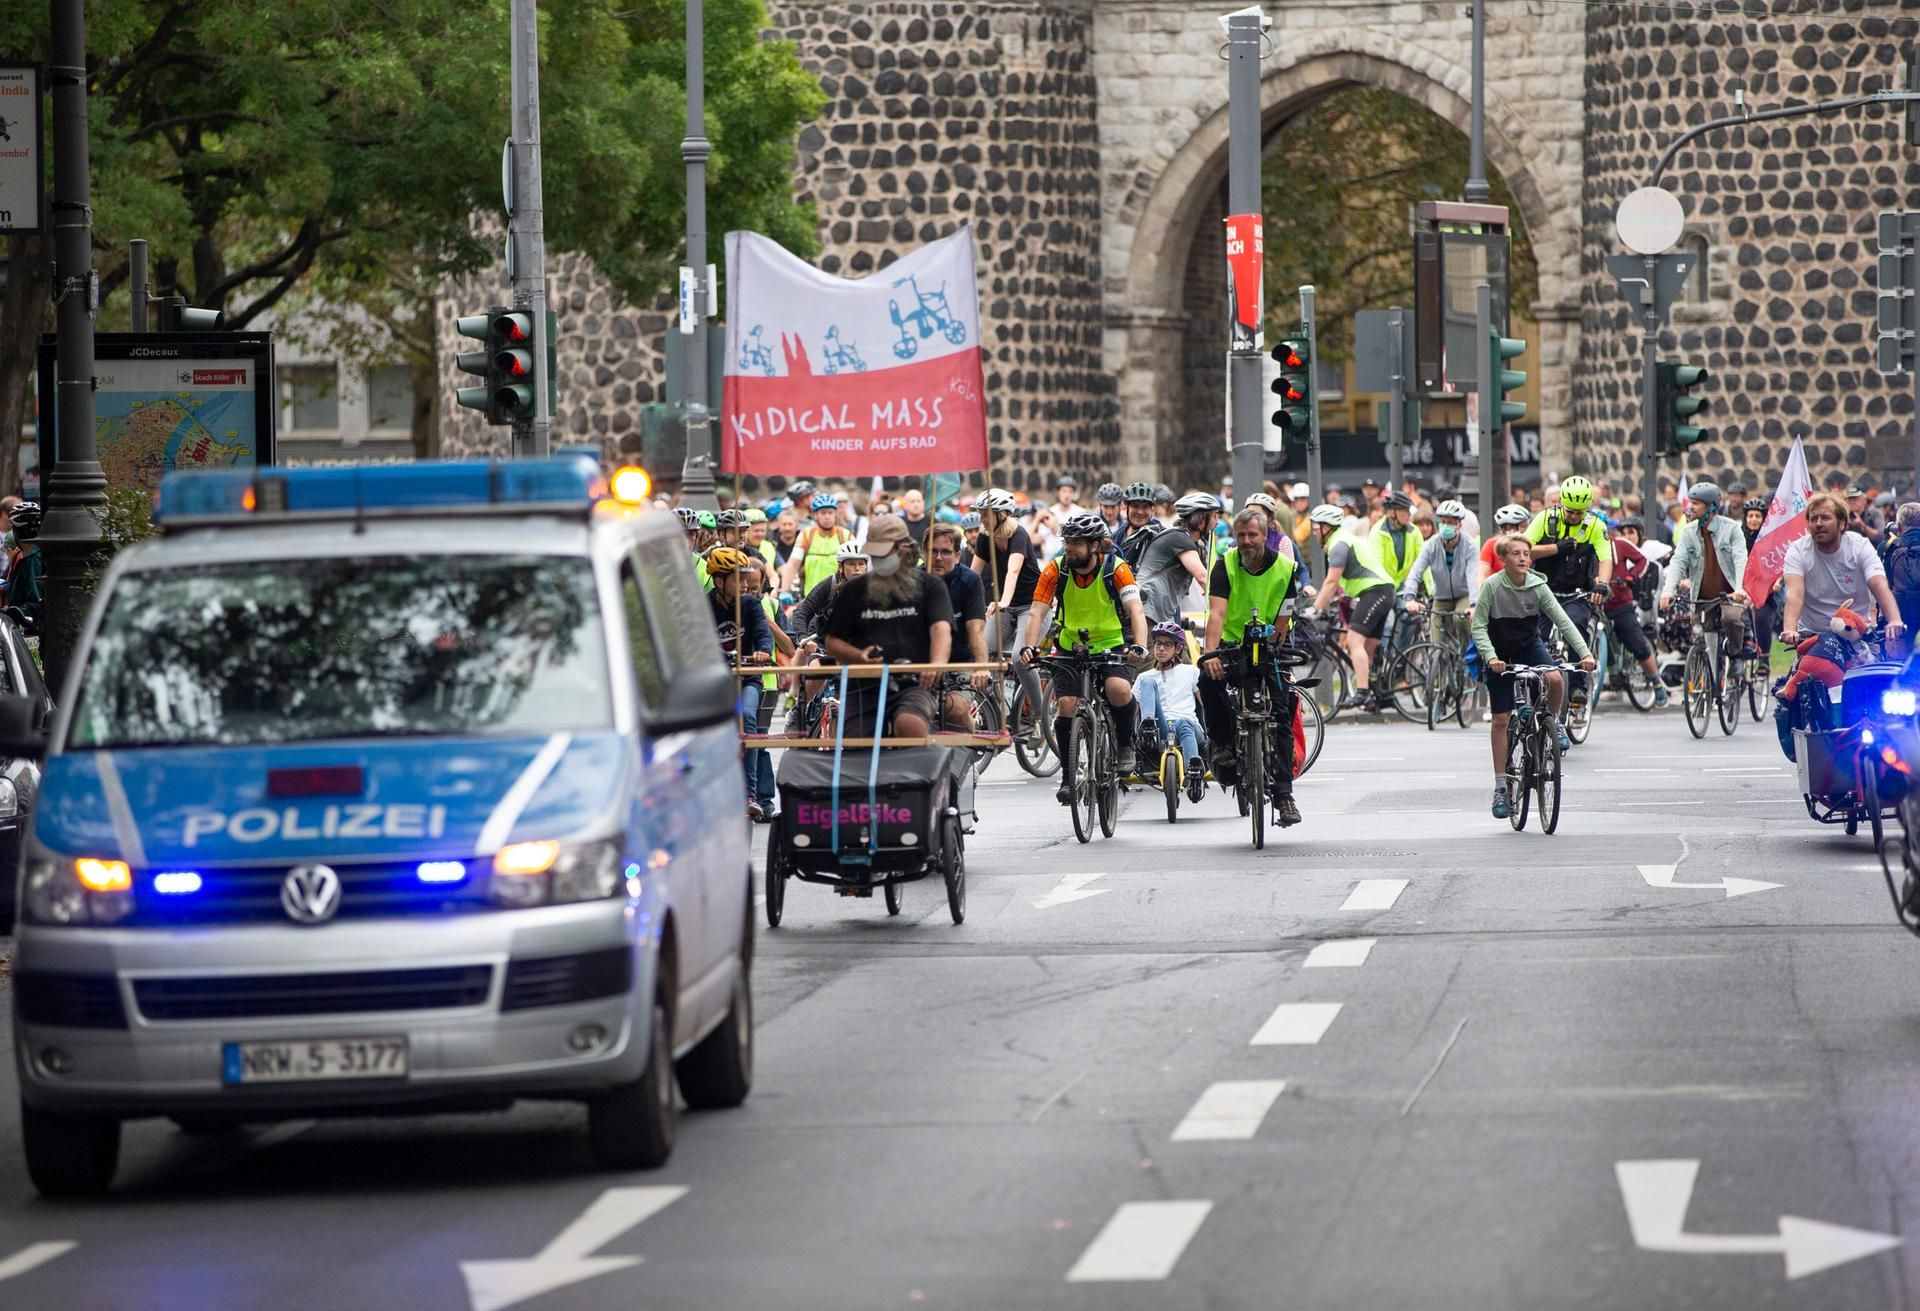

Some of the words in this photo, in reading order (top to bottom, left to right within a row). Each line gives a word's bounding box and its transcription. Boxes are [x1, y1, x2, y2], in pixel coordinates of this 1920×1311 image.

[1, 84, 30, 96] India
[129, 348, 179, 357] JCDecaux
[194, 374, 213, 382] Stadt
[214, 373, 230, 382] Köln
[731, 404, 855, 447] KIDICAL
[872, 397, 943, 431] MASS
[811, 438, 864, 451] KINDER
[182, 804, 447, 847] POLIZEI
[796, 802, 913, 830] EigelBike
[243, 1047, 293, 1073] NRW
